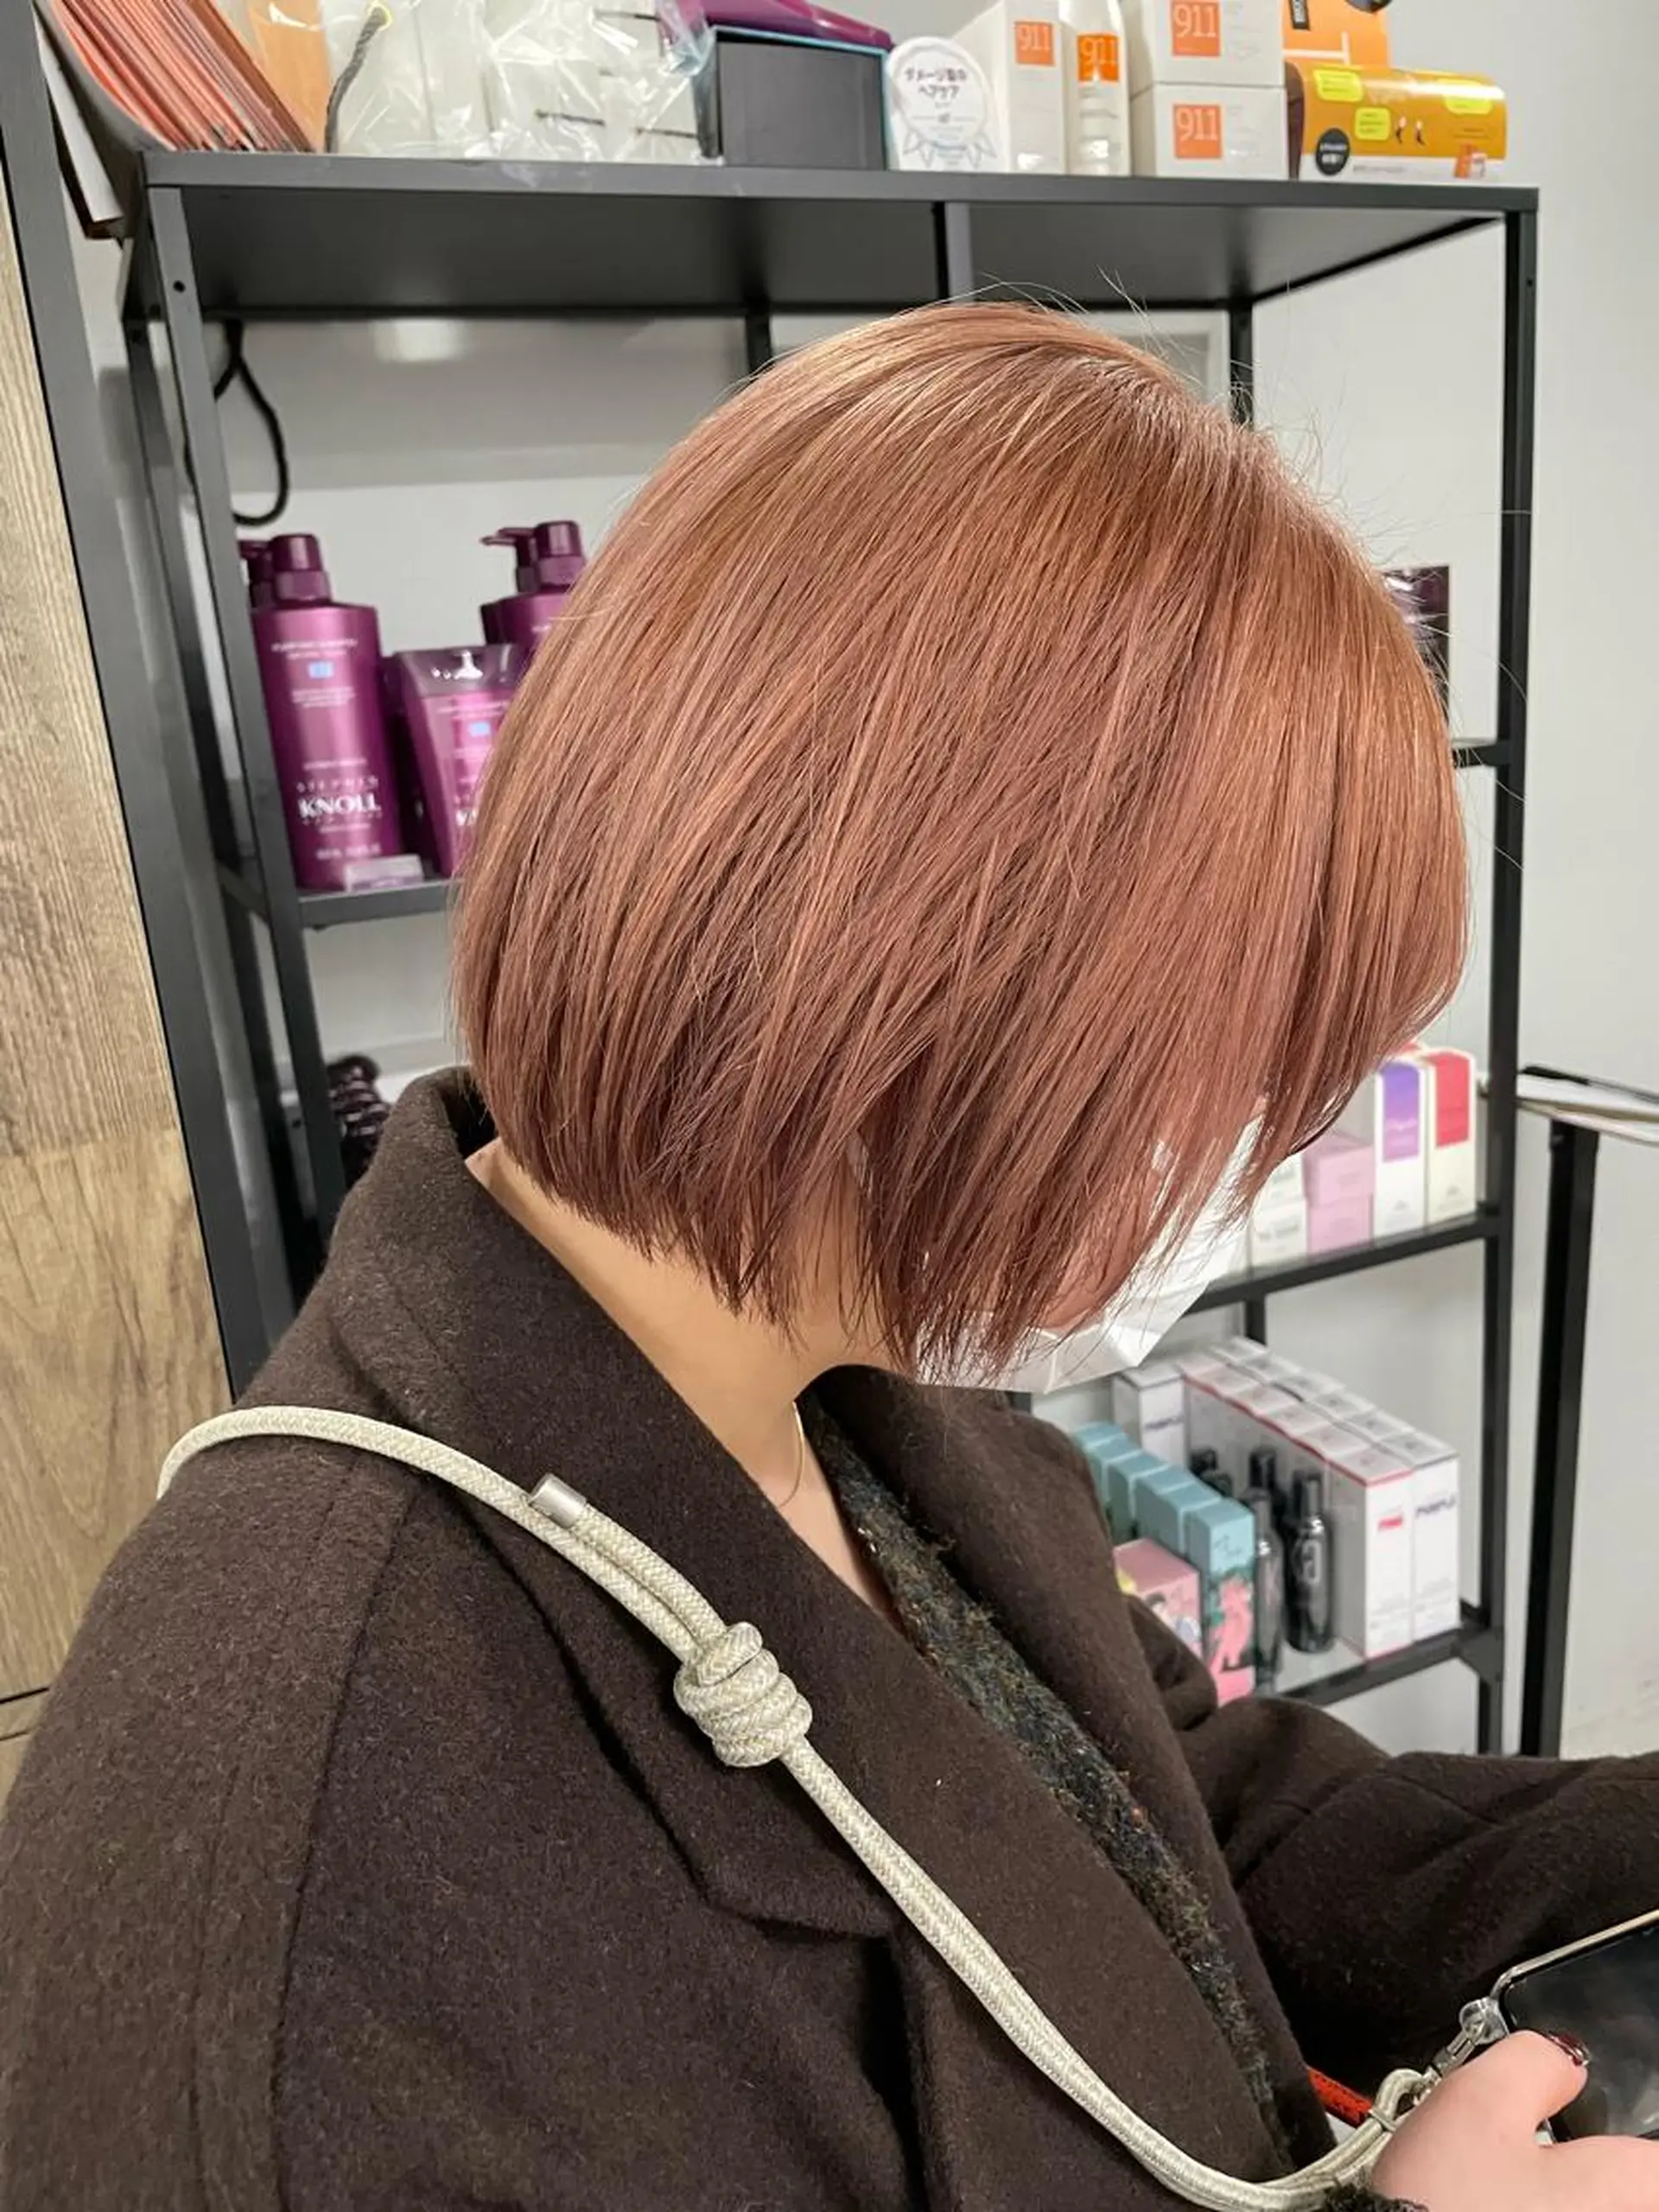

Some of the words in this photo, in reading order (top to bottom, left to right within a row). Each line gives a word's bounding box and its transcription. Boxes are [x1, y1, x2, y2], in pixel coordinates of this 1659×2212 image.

[1174, 4, 1217, 38] 911
[1019, 24, 1052, 53] 911
[1082, 37, 1118, 67] 911
[1176, 107, 1219, 142] 911
[298, 791, 382, 819] KNOLL
